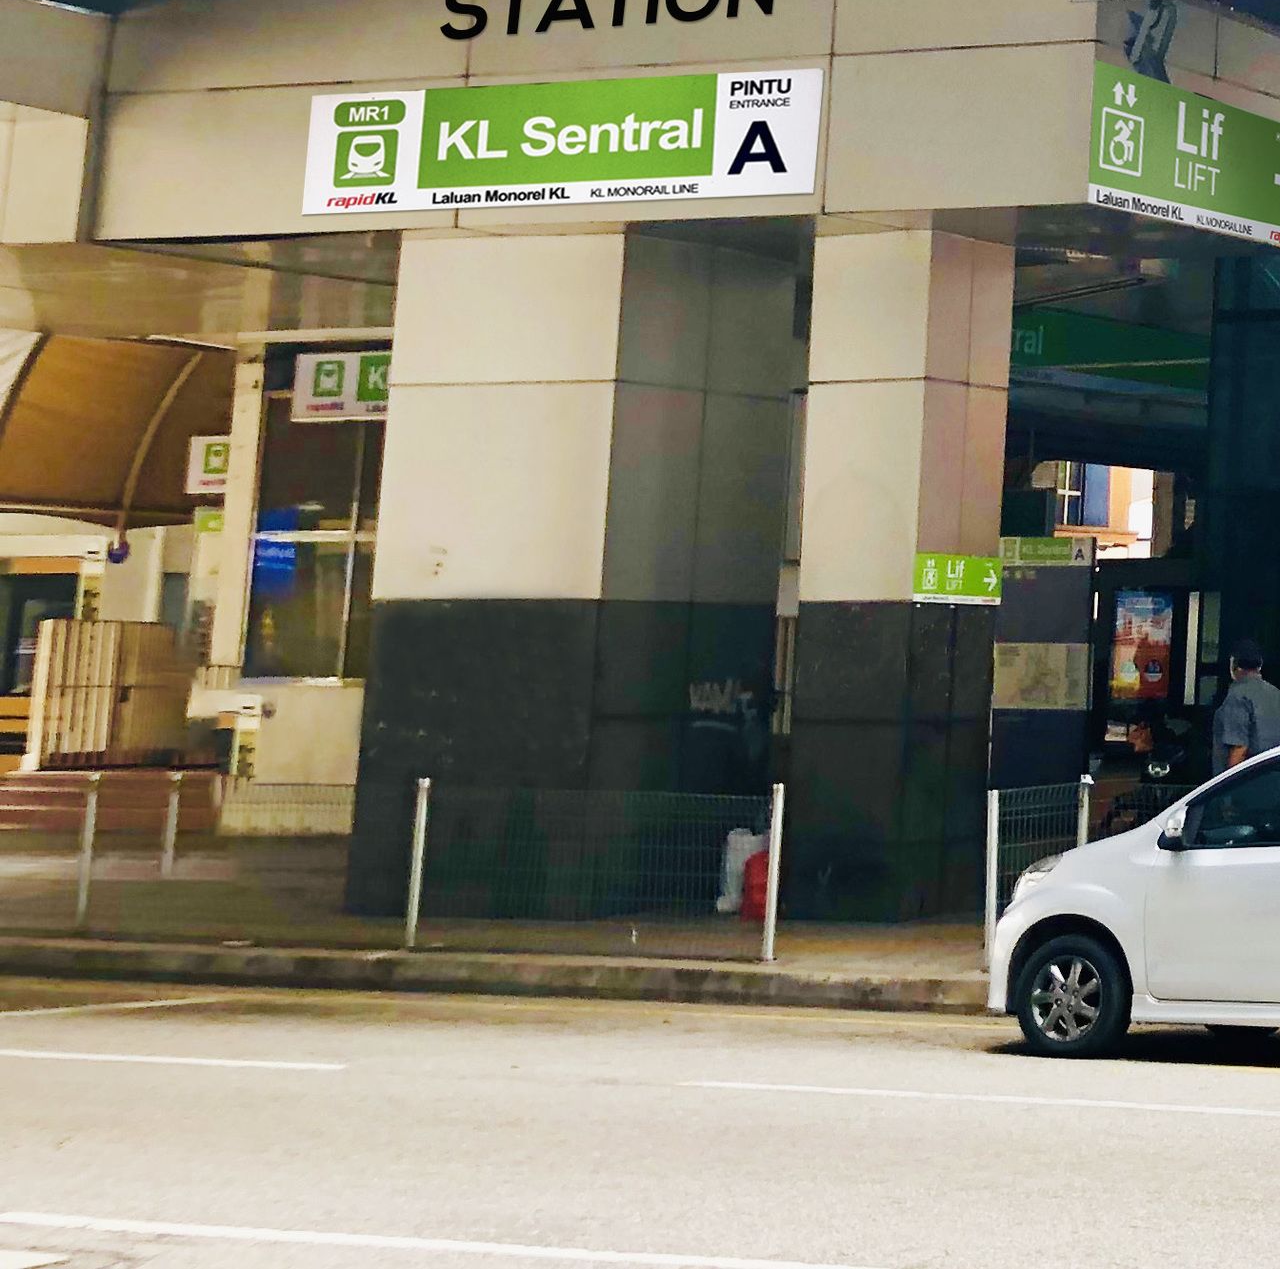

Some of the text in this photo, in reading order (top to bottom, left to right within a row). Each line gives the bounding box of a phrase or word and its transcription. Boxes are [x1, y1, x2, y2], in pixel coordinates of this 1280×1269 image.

[730, 78, 792, 97] PINTU
[729, 97, 791, 110] ENTRANCE
[348, 105, 390, 123] MR1
[437, 107, 704, 162] KL Sentral
[1176, 101, 1225, 161] Lif
[727, 120, 788, 176] A
[1174, 157, 1221, 196] LIFT
[432, 187, 571, 205] Laluan Monorel KL
[590, 182, 700, 199] KL MONORAIL LINE
[326, 191, 398, 210] rapidKL
[1096, 189, 1184, 221] Laluan Monorel KL
[1075, 548, 1085, 561] A
[947, 560, 965, 579] Lif
